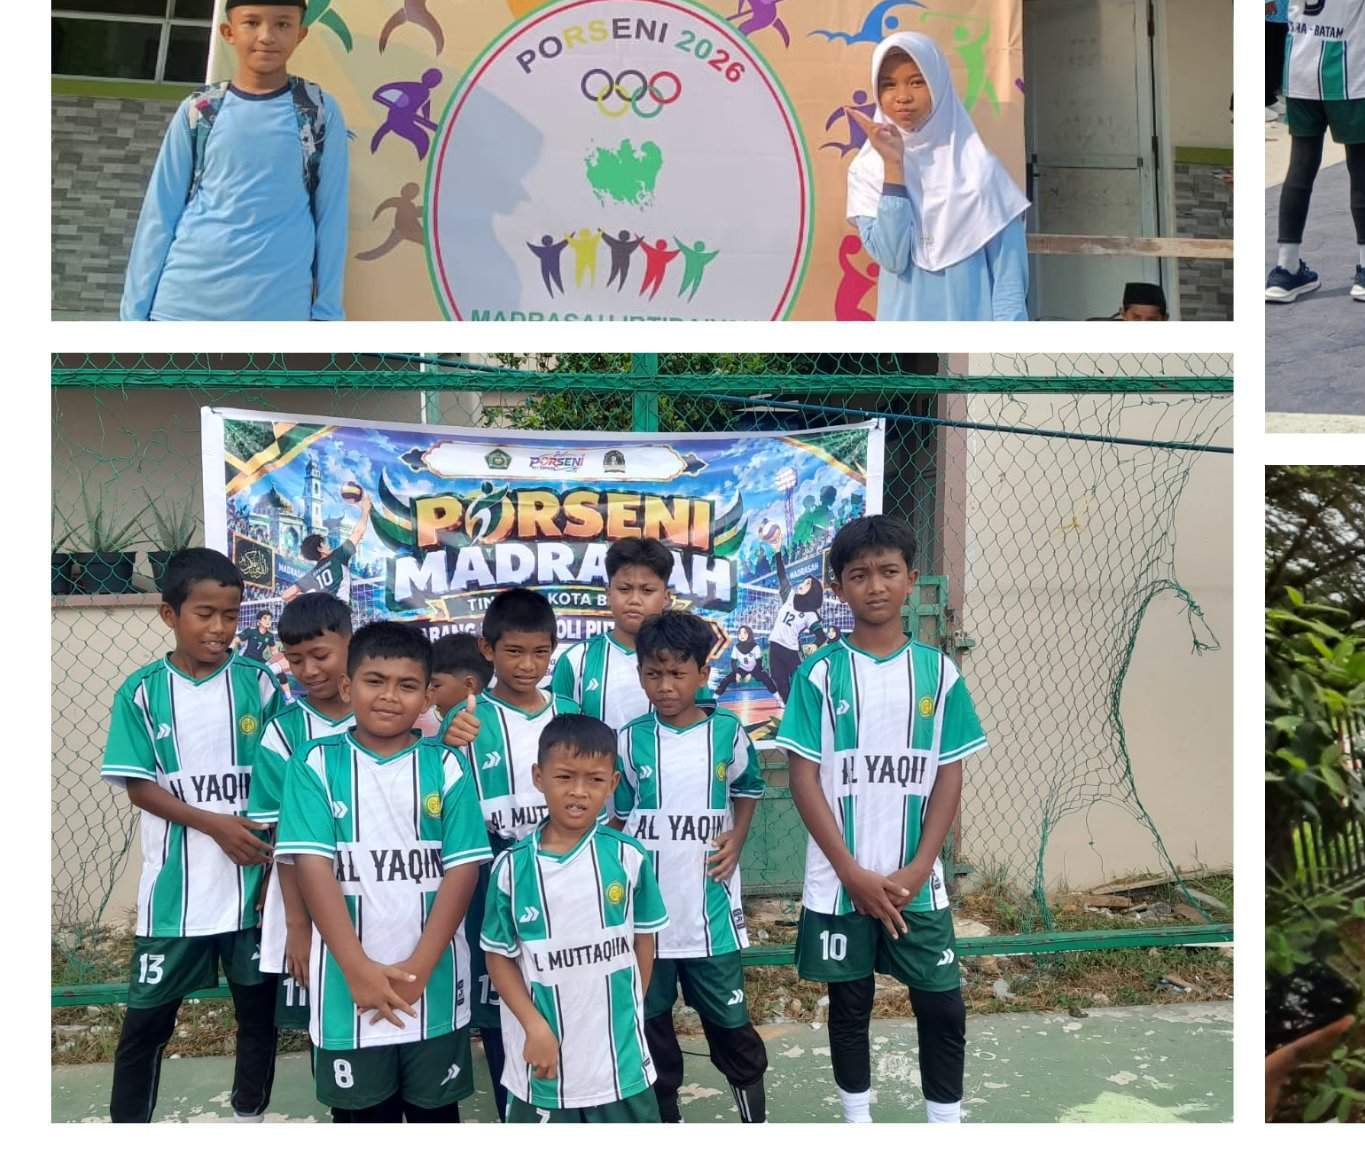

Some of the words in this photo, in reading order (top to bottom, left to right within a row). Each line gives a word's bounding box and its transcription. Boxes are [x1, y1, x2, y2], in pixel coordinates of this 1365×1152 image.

[1314, 24, 1345, 39] BATAM
[515, 17, 669, 74] PORSENI
[674, 30, 746, 83] 2026
[529, 452, 585, 469] PORSENI
[413, 486, 714, 552] PORSENI
[315, 568, 334, 589] 10
[395, 542, 733, 603] MADRAAH
[549, 593, 592, 607] KOTA
[781, 611, 796, 626] 12
[491, 808, 506, 830] AL
[634, 816, 660, 840] AL
[668, 816, 724, 845] YAQIN
[369, 848, 444, 885] YAQIN
[820, 930, 847, 960] 10
[137, 952, 165, 984] 13
[283, 977, 306, 1007] 11
[333, 1058, 354, 1088] 8
